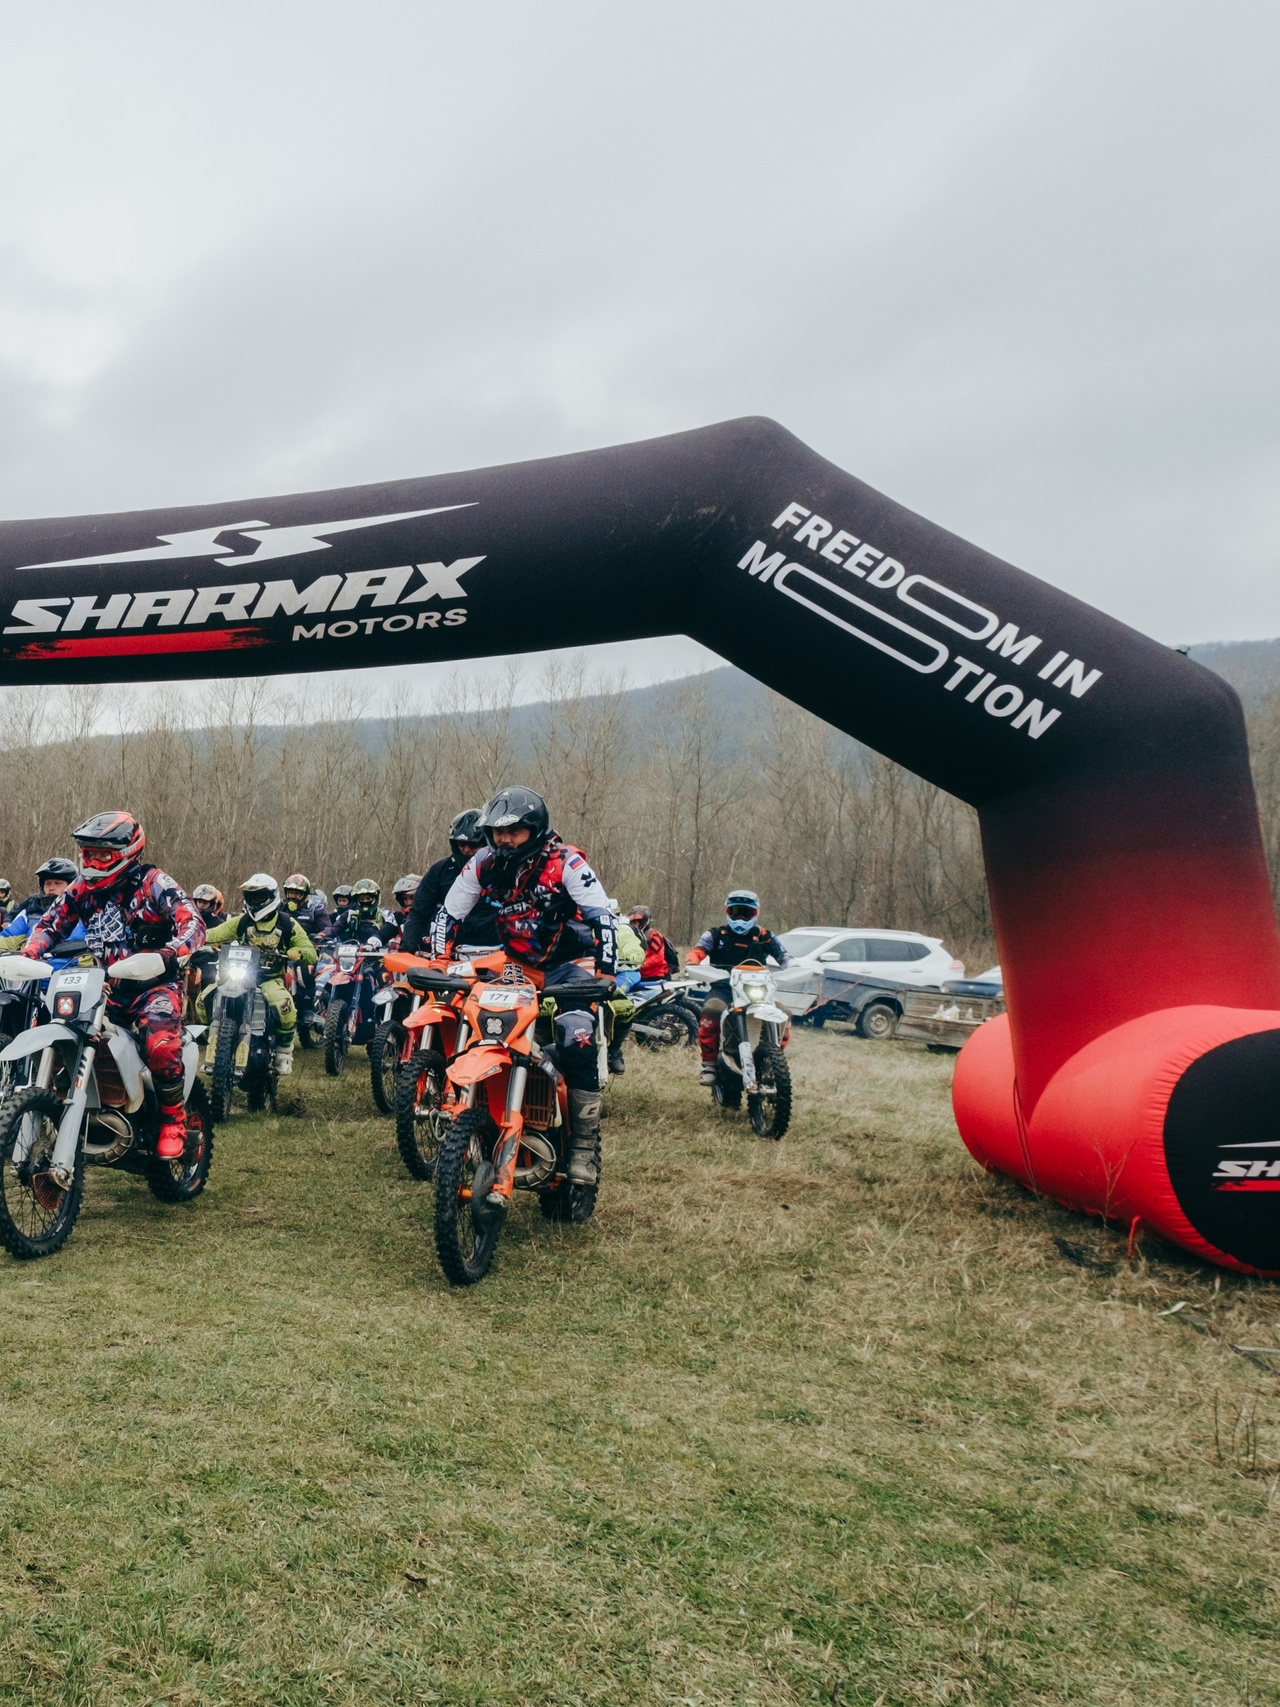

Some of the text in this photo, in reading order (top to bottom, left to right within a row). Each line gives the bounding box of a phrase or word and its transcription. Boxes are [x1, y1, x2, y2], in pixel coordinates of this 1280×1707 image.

[3, 555, 487, 634] SHARMAX
[771, 502, 1103, 698] FREEDOM IN
[292, 608, 468, 642] MOTORS
[736, 540, 1062, 740] MOTION
[63, 976, 82, 985] 133
[489, 993, 509, 1002] 171
